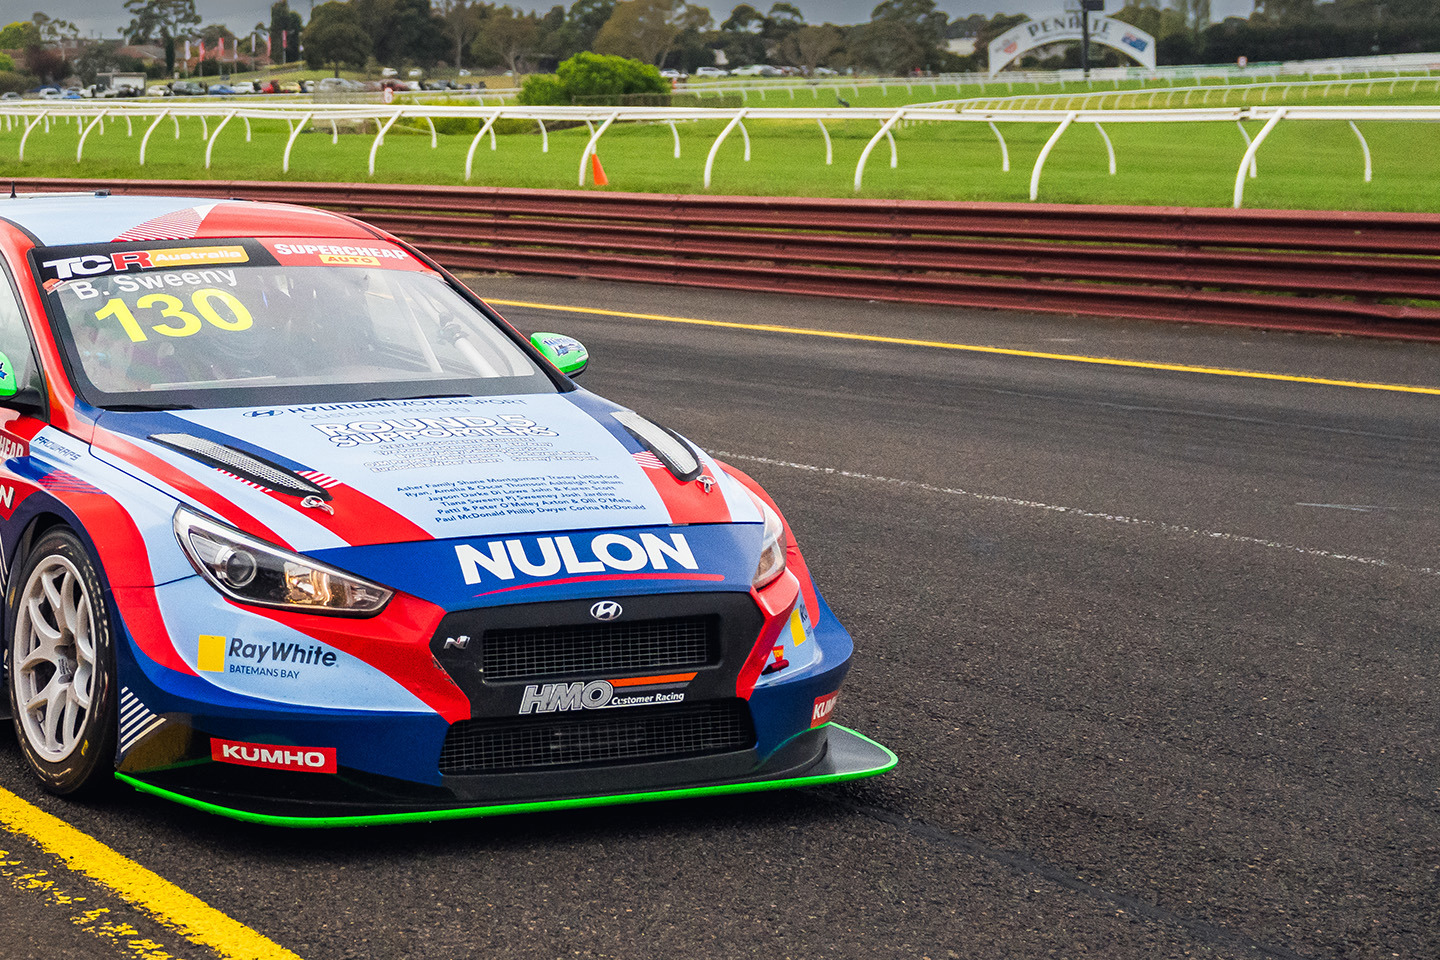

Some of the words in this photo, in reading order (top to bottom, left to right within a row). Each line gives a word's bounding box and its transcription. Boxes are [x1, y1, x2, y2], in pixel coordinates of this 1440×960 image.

[274, 244, 409, 260] SUPERCHEAP
[328, 256, 373, 264] AUTO
[43, 250, 154, 279] TCR
[156, 250, 242, 262] Australia
[69, 281, 109, 300] B.
[114, 270, 238, 292] Sweeny
[94, 288, 254, 342] 130
[288, 400, 391, 414] HYUNDAI
[301, 408, 390, 421] Customer
[311, 415, 498, 438] ROUND
[496, 414, 537, 430] 5
[329, 426, 560, 448] SUPPORTERS
[458, 510, 505, 520] McDonald
[454, 533, 698, 585] NULON
[228, 638, 337, 667] RayWhite
[230, 664, 279, 677] BATEMANS
[280, 668, 300, 679] BAY
[518, 680, 614, 714] HMO
[612, 694, 654, 706] Customer
[656, 692, 684, 702] Racing
[222, 744, 325, 767] KUMHO
